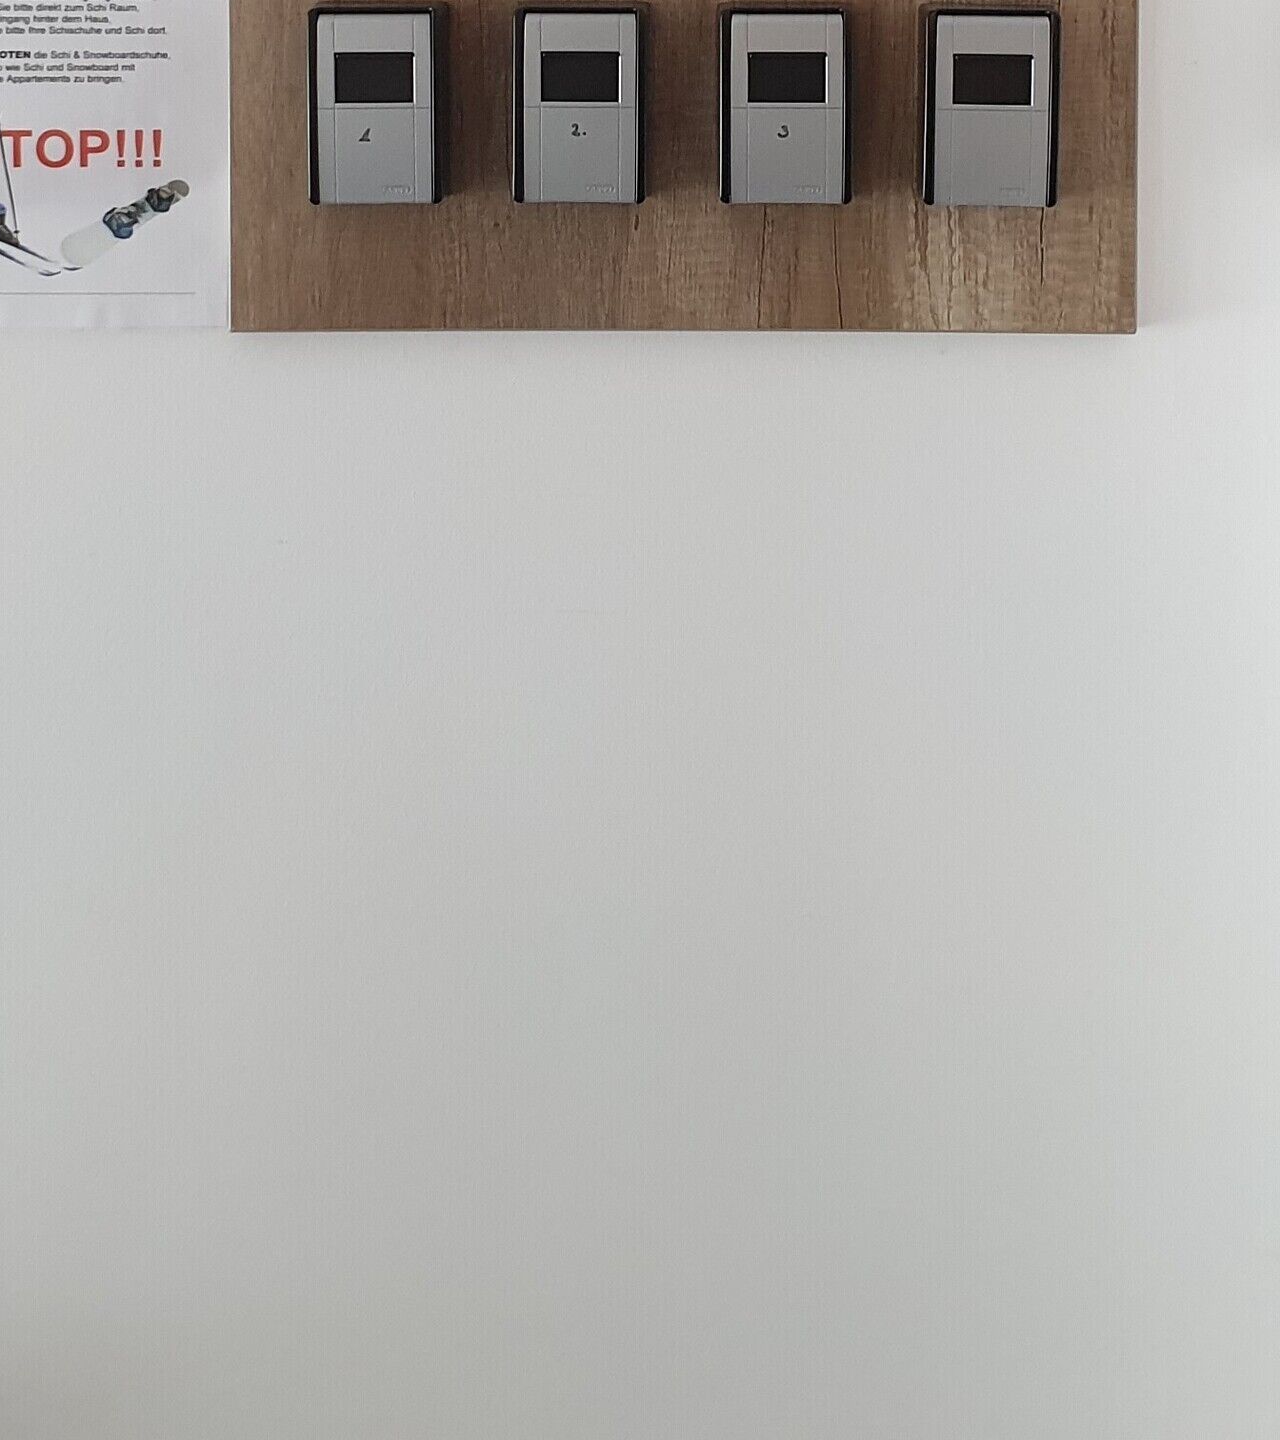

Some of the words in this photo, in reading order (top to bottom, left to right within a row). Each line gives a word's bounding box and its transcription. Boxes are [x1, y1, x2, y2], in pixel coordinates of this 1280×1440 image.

[13, 3, 34, 12] bitte
[35, 3, 62, 12] direkt
[64, 3, 85, 12] zum
[32, 14, 59, 23] hinter
[61, 14, 83, 23] dem
[5, 25, 26, 35] bitte
[104, 25, 123, 35] und
[33, 50, 49, 60] die
[50, 50, 71, 60] Schi
[72, 50, 81, 60] &
[4, 62, 21, 72] wie
[46, 62, 65, 72] und
[66, 62, 120, 72] Snowboard
[121, 62, 136, 72] mit
[73, 75, 85, 83] zu
